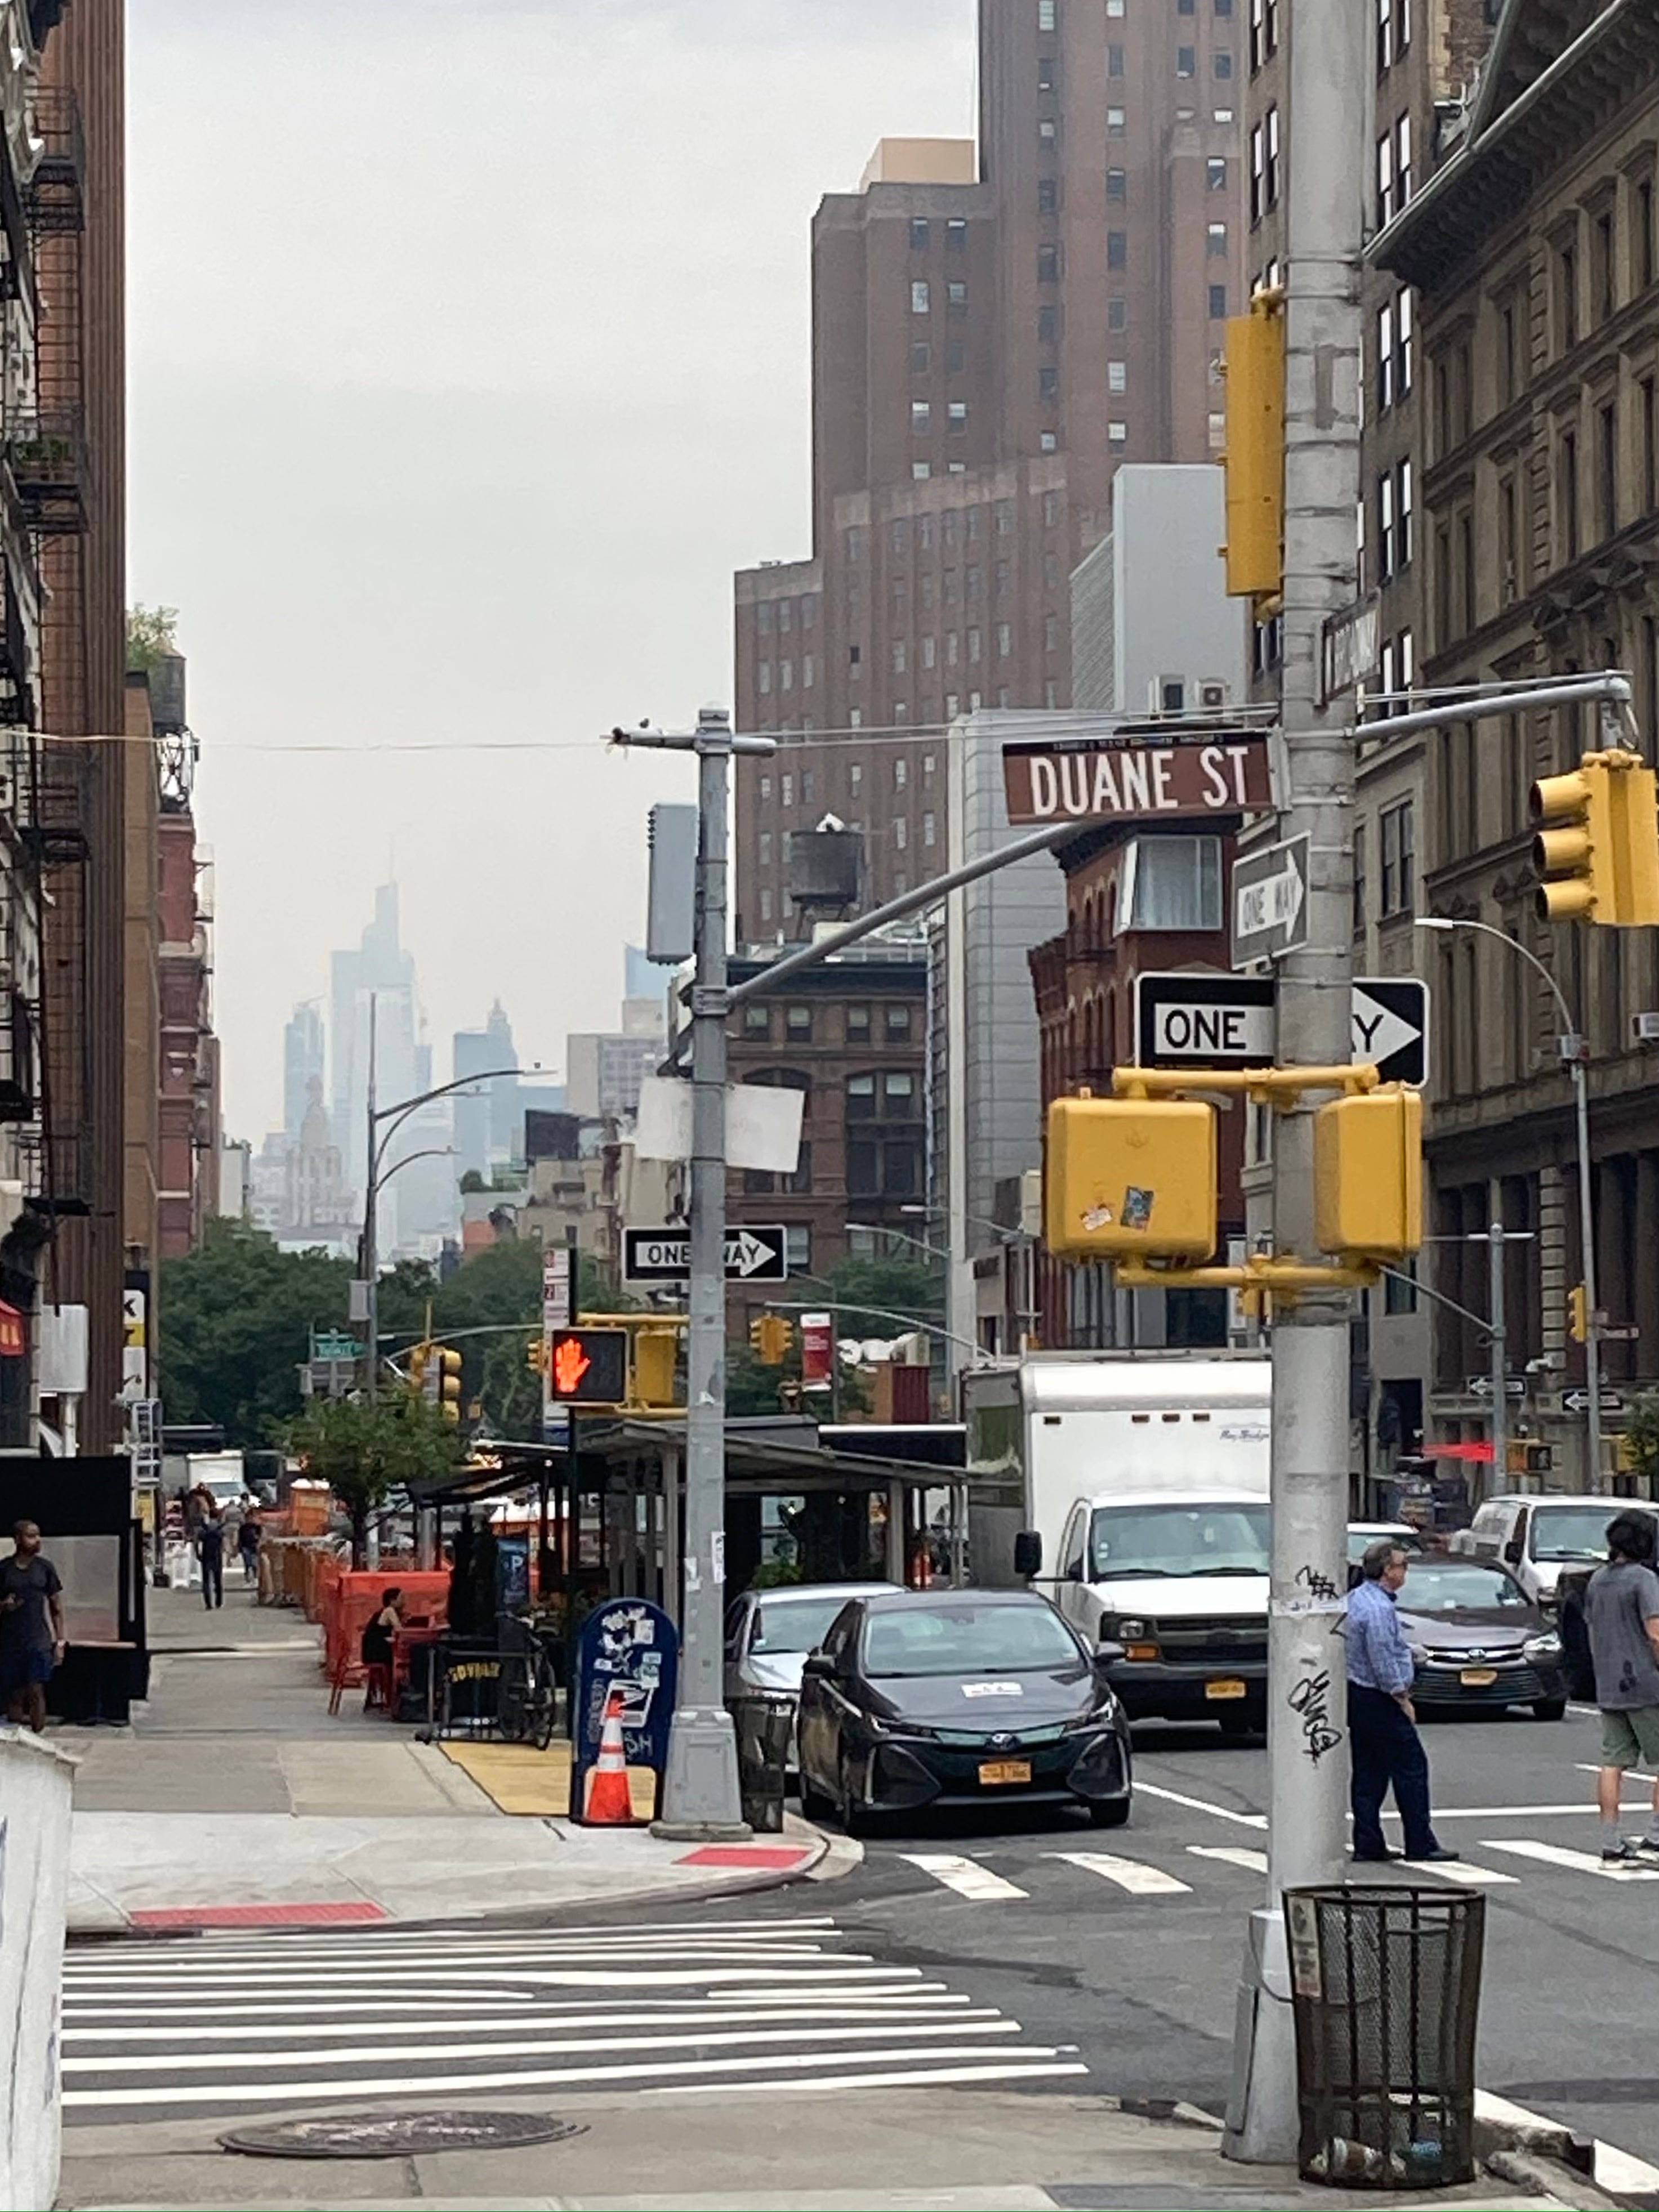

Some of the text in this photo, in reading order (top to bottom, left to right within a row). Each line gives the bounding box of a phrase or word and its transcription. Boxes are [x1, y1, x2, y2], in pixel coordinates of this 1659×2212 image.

[1029, 746, 1248, 816] DUANE ST
[1242, 886, 1265, 930] ONE
[1164, 1009, 1246, 1050] ONE
[648, 1244, 691, 1264] ONE
